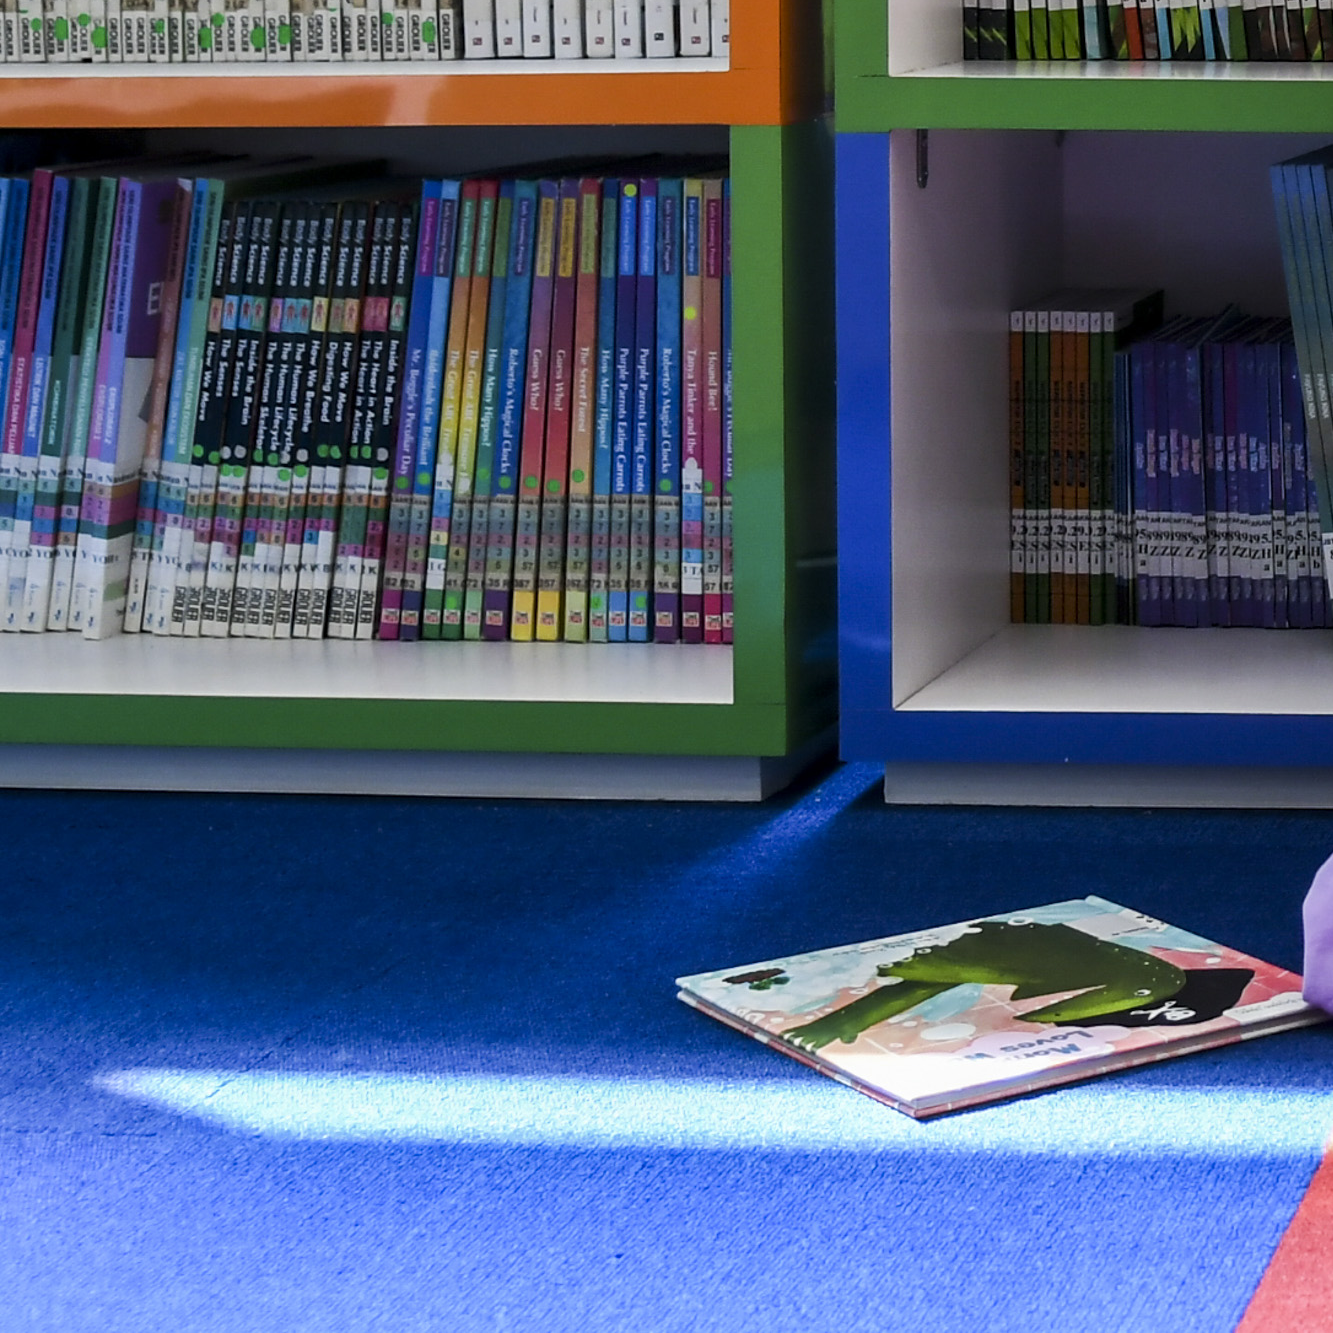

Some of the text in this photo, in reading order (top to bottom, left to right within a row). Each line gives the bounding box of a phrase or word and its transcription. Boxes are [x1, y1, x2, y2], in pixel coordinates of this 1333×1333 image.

[397, 218, 411, 284] Body Science
[369, 362, 381, 394] Heart
[372, 341, 383, 359] The
[529, 349, 543, 411] Guess Who?
[708, 351, 718, 386] Hound
[301, 340, 320, 433] How We Breathe
[320, 342, 338, 422] Digesting Food
[382, 340, 399, 425] Inside the Brain
[364, 410, 375, 444] Action
[614, 348, 630, 492] Purple Parrots Eating Carrots
[1000, 1029, 1094, 1053] Loves
